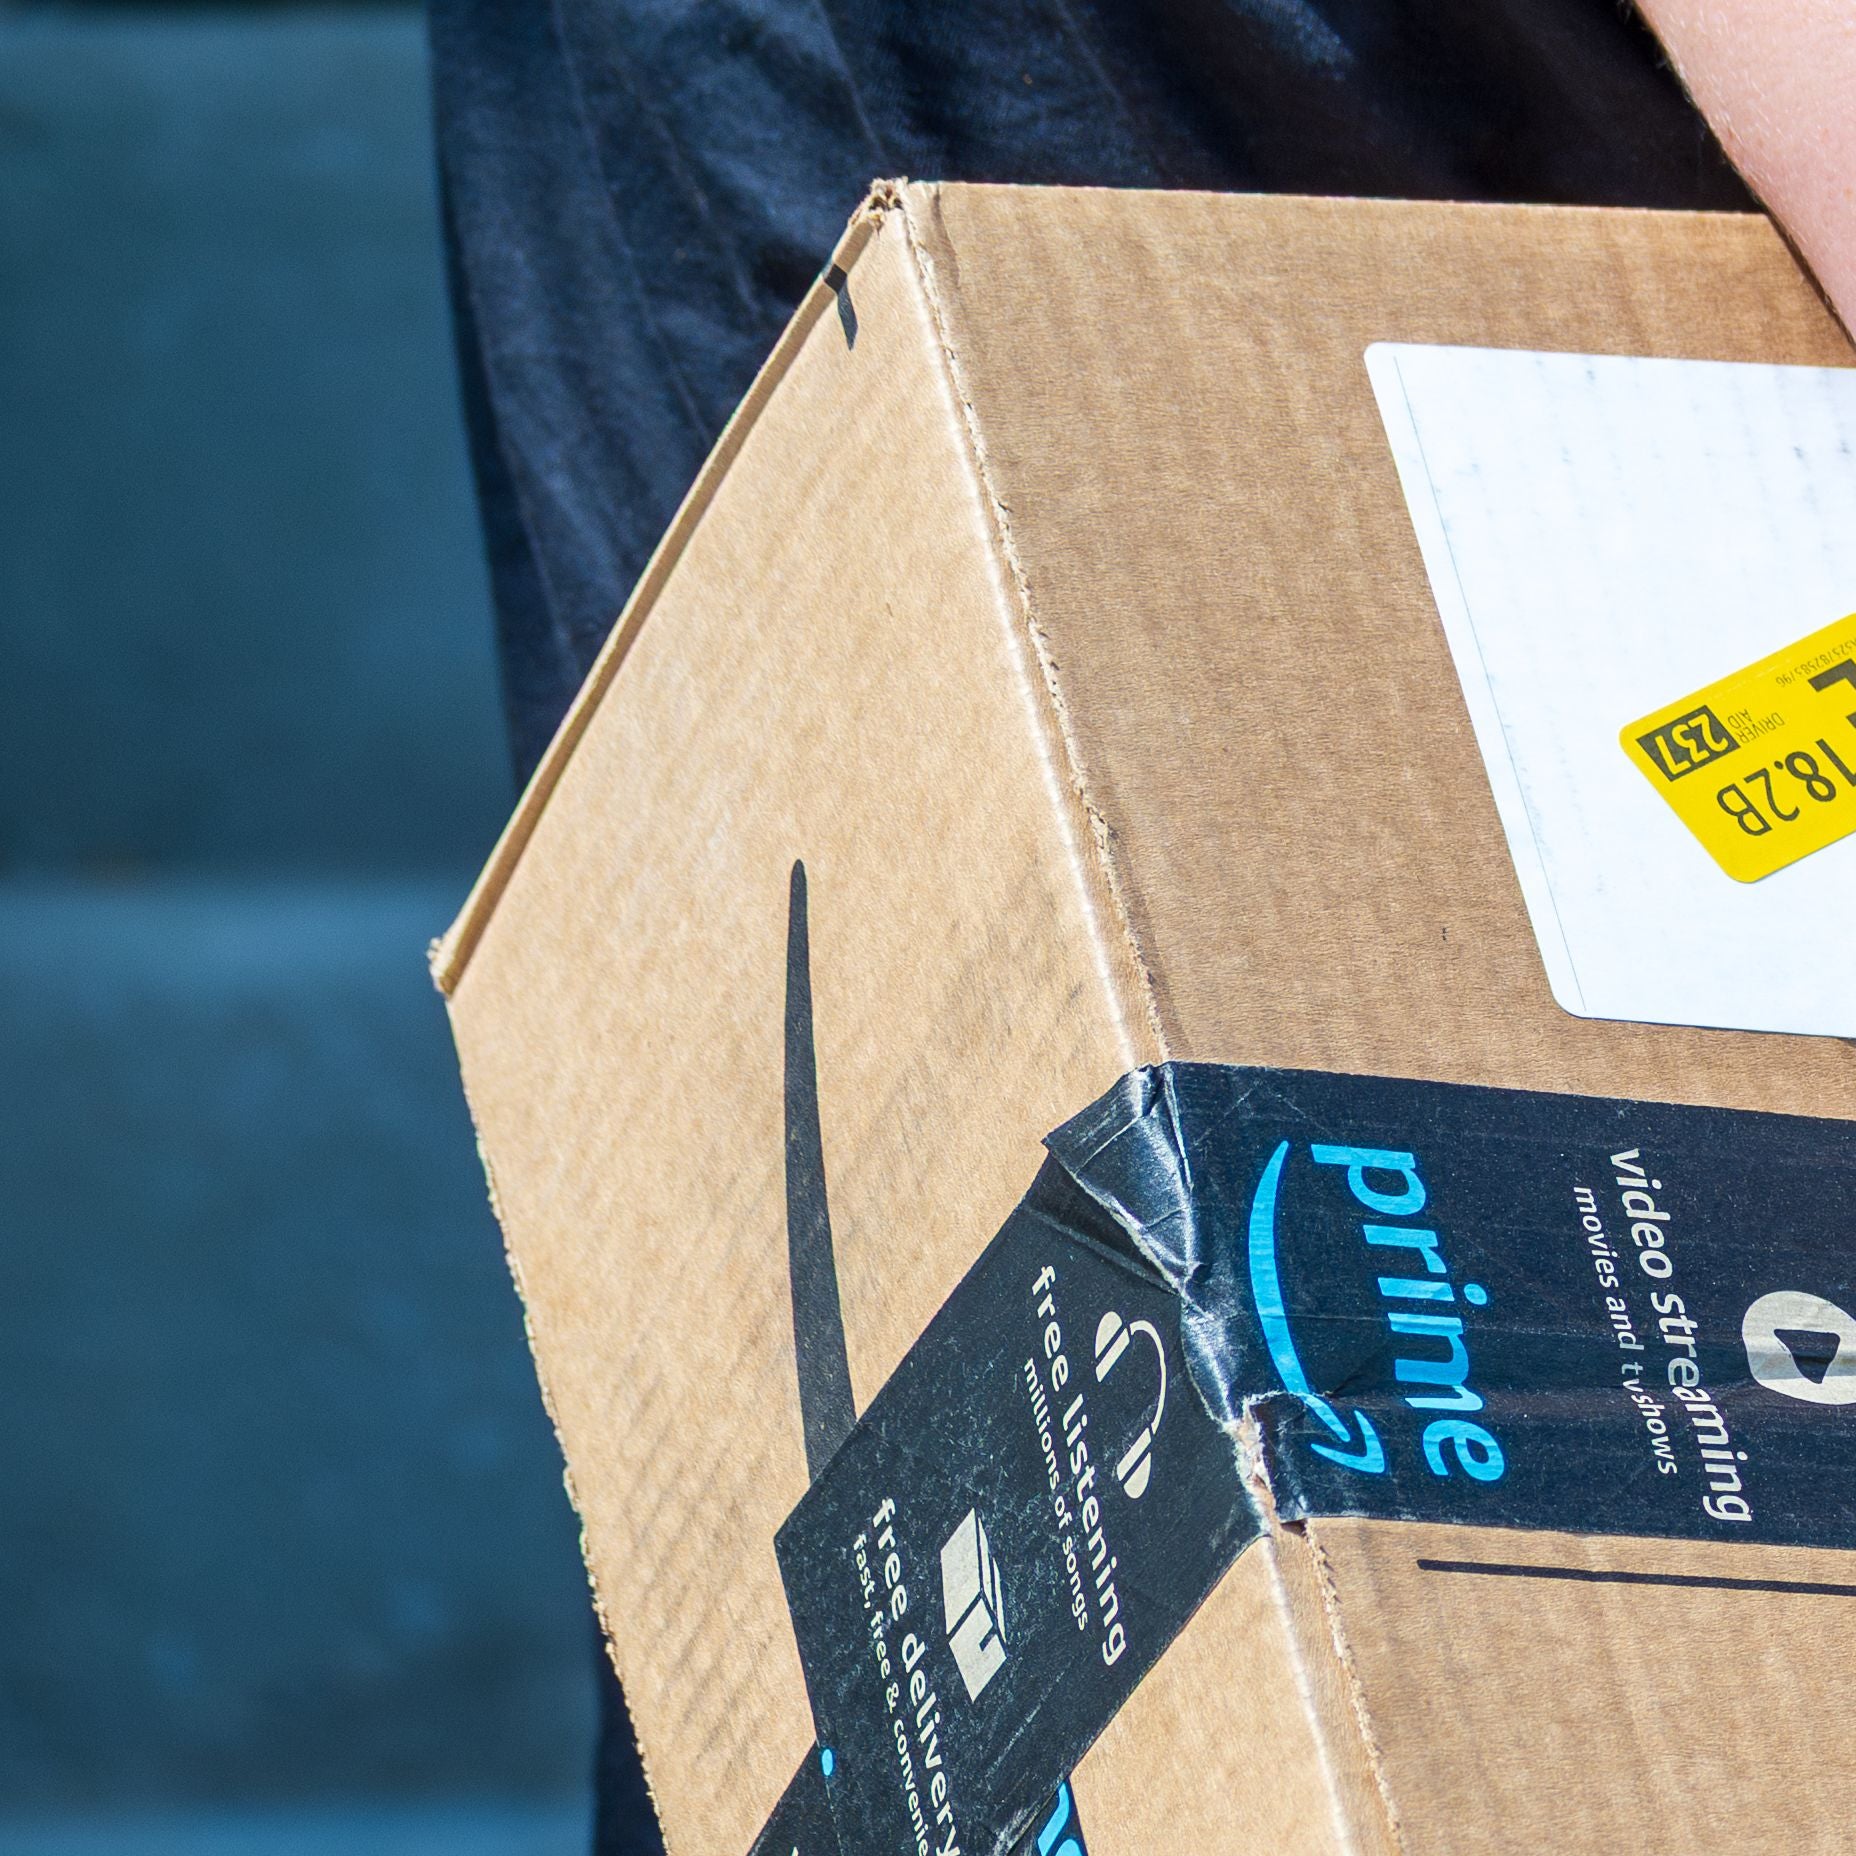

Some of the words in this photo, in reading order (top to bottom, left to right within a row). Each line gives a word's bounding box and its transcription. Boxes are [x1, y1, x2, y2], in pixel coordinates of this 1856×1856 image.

[1655, 712, 1729, 775] 237
[1727, 708, 1749, 731] AID
[1736, 711, 1785, 745] DRIVER
[1311, 1143, 1505, 1481] prime
[1573, 1186, 1619, 1289] movies
[1606, 1296, 1645, 1351] and
[1610, 1147, 1673, 1279] video
[1651, 1292, 1752, 1522] streaming
[1025, 1358, 1060, 1491] millions
[1032, 1265, 1069, 1392] free
[1062, 1393, 1127, 1666] listening
[872, 1498, 908, 1622] free
[1055, 1494, 1073, 1530] of
[853, 1533, 875, 1608] fast,
[872, 1610, 891, 1679] free
[886, 1682, 898, 1712] &
[1063, 1537, 1088, 1631] songs
